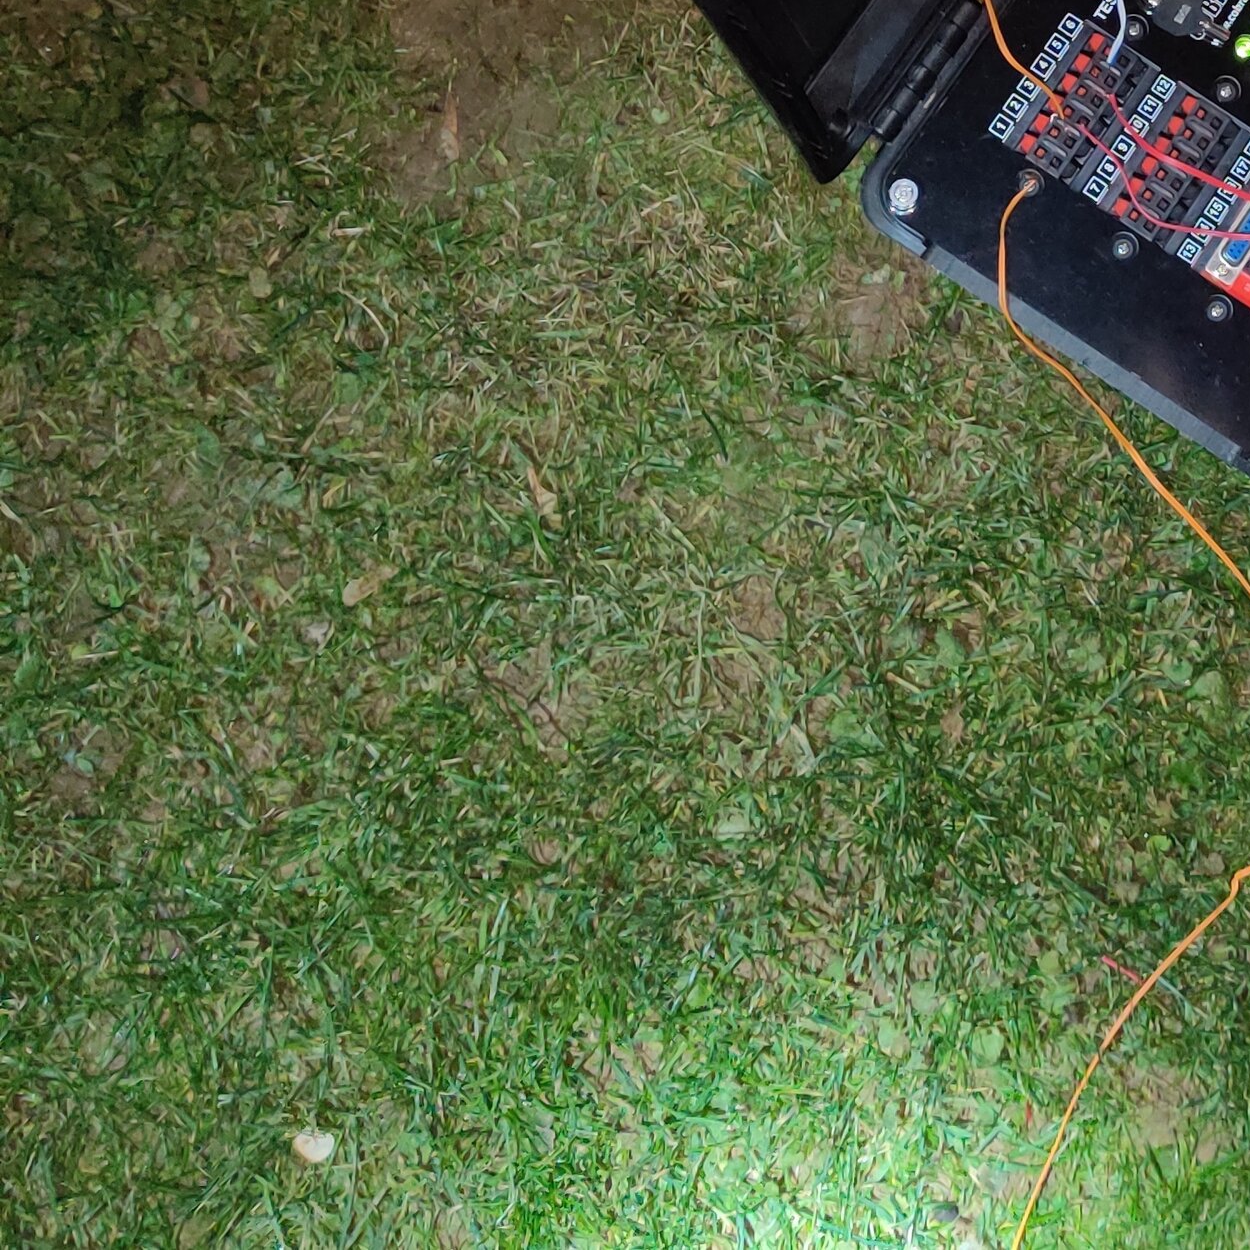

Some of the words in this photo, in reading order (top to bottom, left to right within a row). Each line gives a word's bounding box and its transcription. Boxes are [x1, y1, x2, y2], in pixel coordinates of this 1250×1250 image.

[995, 120, 1008, 132] 1
[1010, 99, 1023, 111] 2
[1023, 79, 1036, 92] 3
[1037, 59, 1050, 71] 4
[1051, 39, 1063, 51] 5
[1065, 20, 1077, 31] 6
[1089, 182, 1103, 196] 7
[1103, 162, 1116, 174] 8
[1117, 141, 1130, 153] 9
[1143, 98, 1159, 115] 11
[1155, 78, 1171, 95] 12
[1181, 243, 1198, 261] 13
[1208, 201, 1224, 217] 15
[1234, 159, 1250, 177] 17
